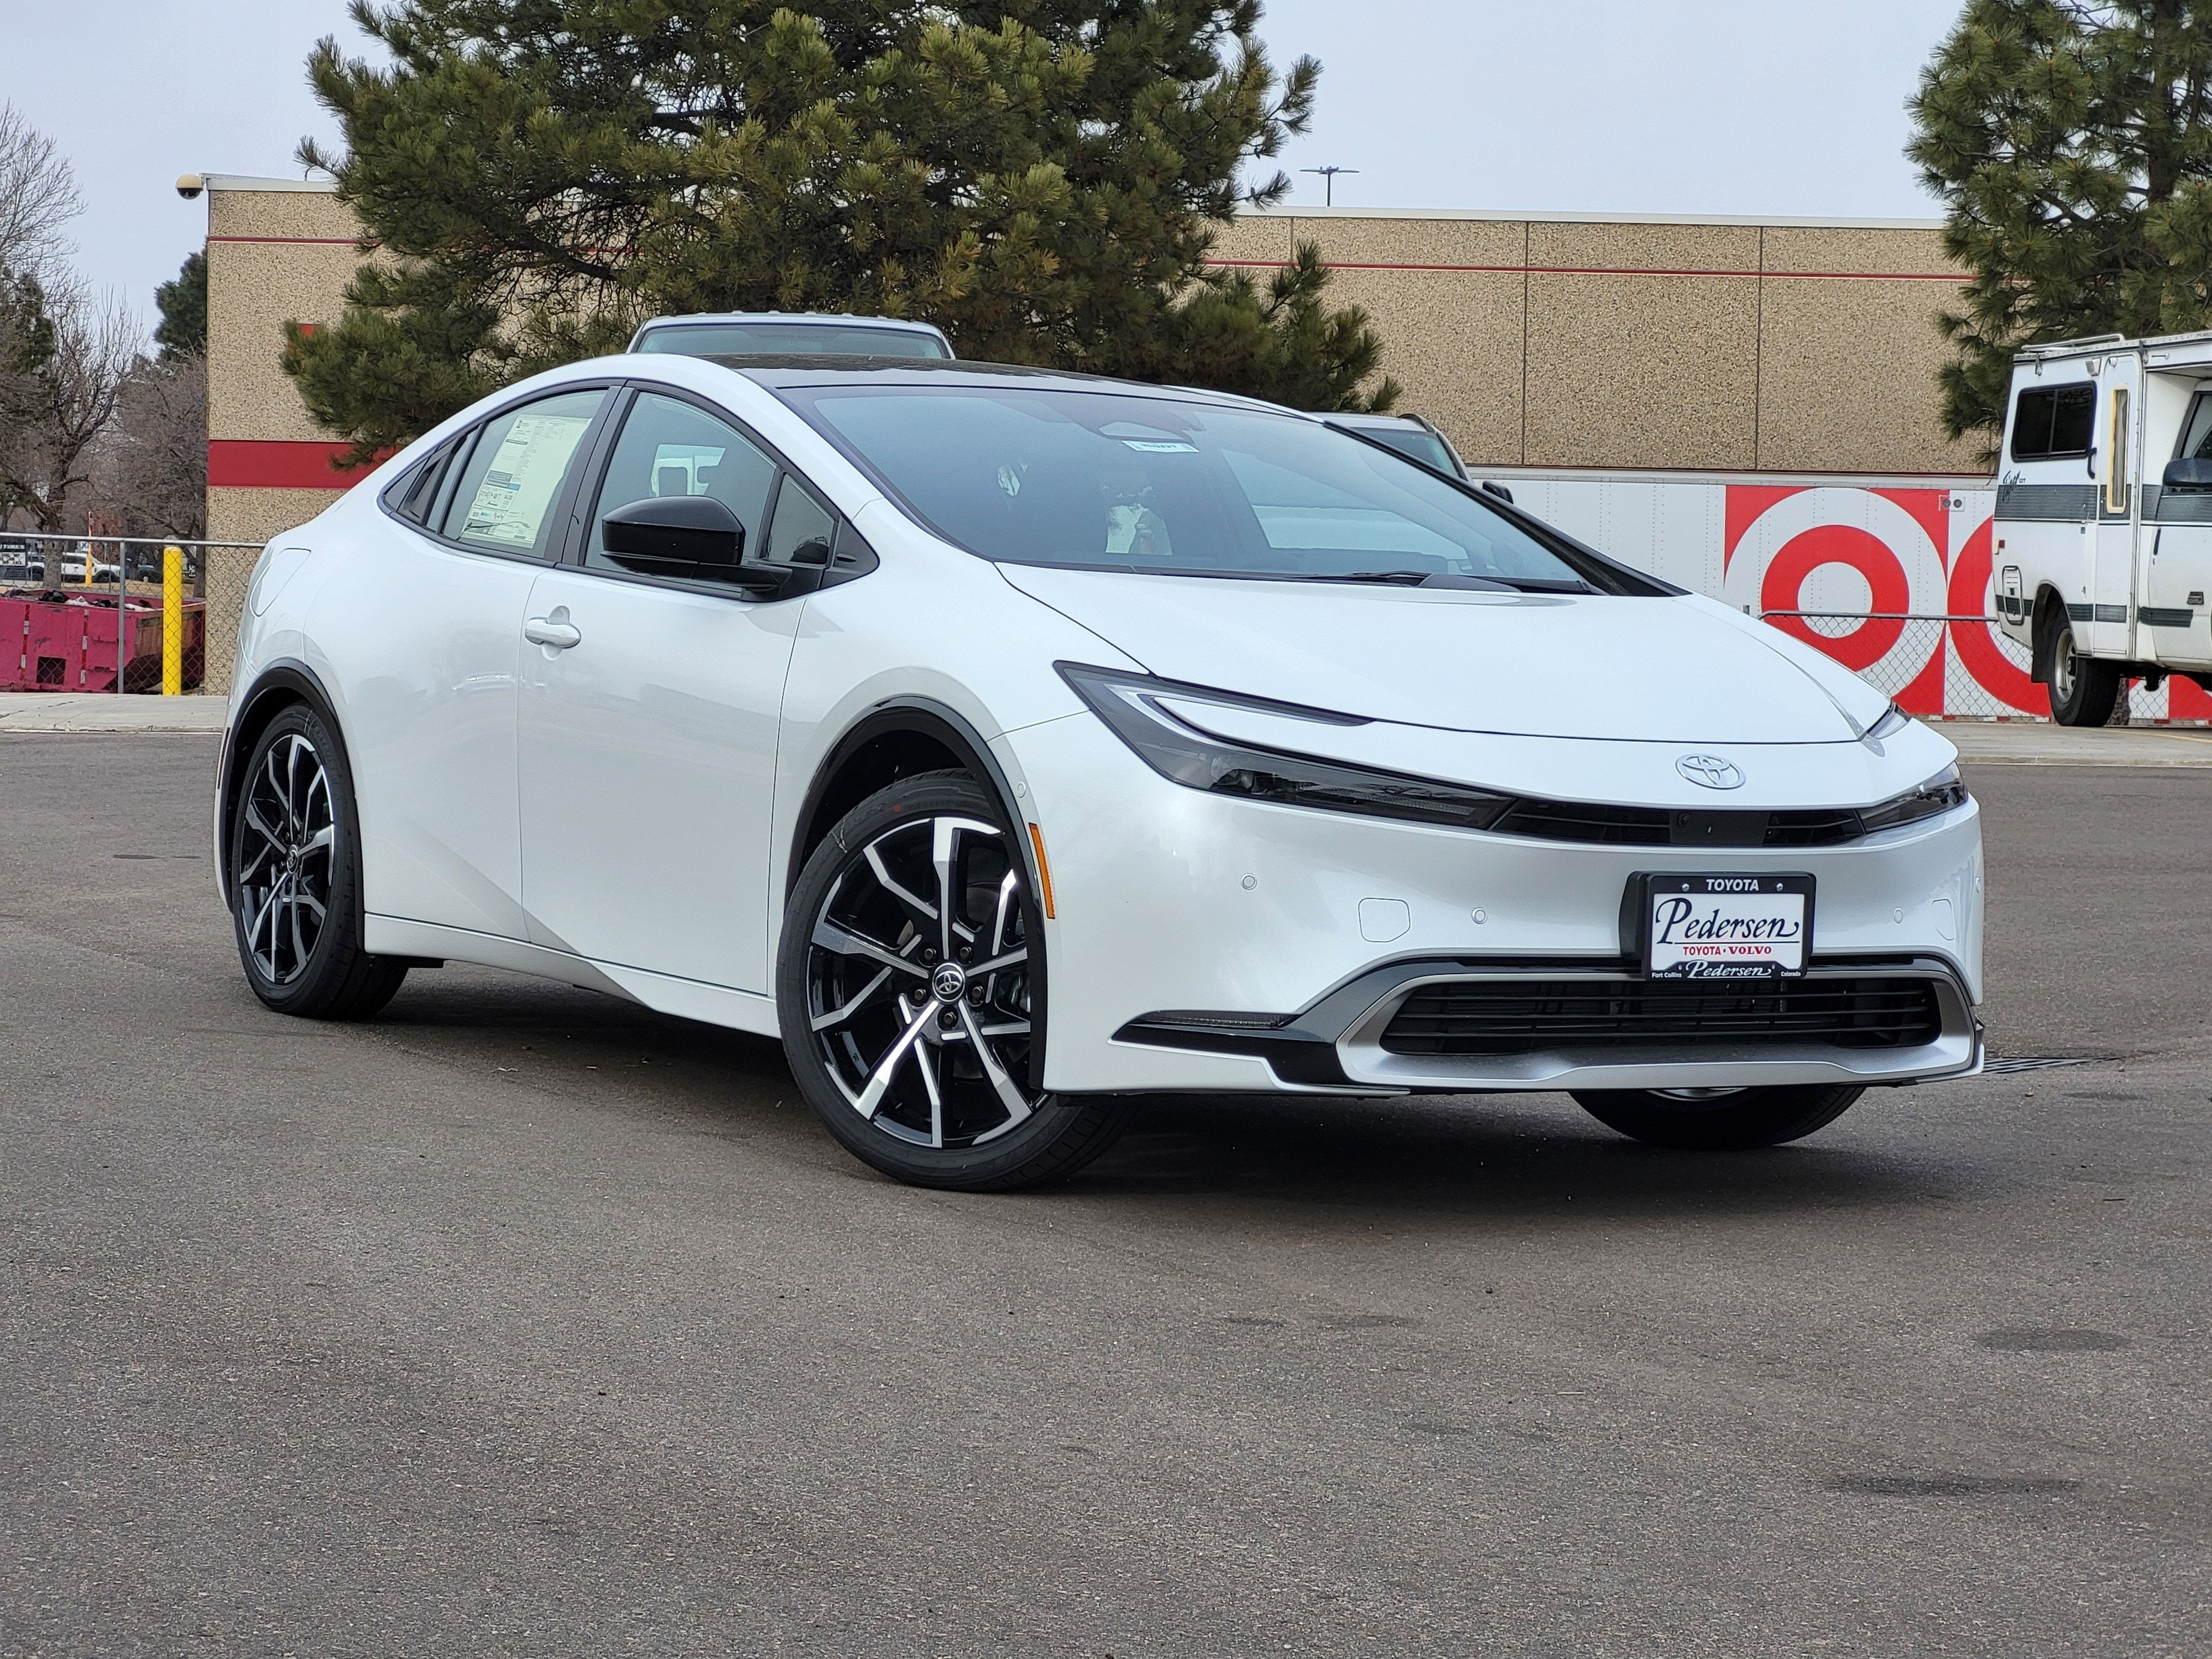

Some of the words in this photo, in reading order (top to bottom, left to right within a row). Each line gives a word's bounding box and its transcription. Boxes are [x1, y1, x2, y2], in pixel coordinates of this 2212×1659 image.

[1706, 879, 1760, 891] TOYOTA
[1655, 897, 1799, 945] Pedersen
[1683, 946, 1721, 956] TOYOTA
[1728, 946, 1772, 955] VOLVO
[1686, 959, 1772, 978] Pedersen
